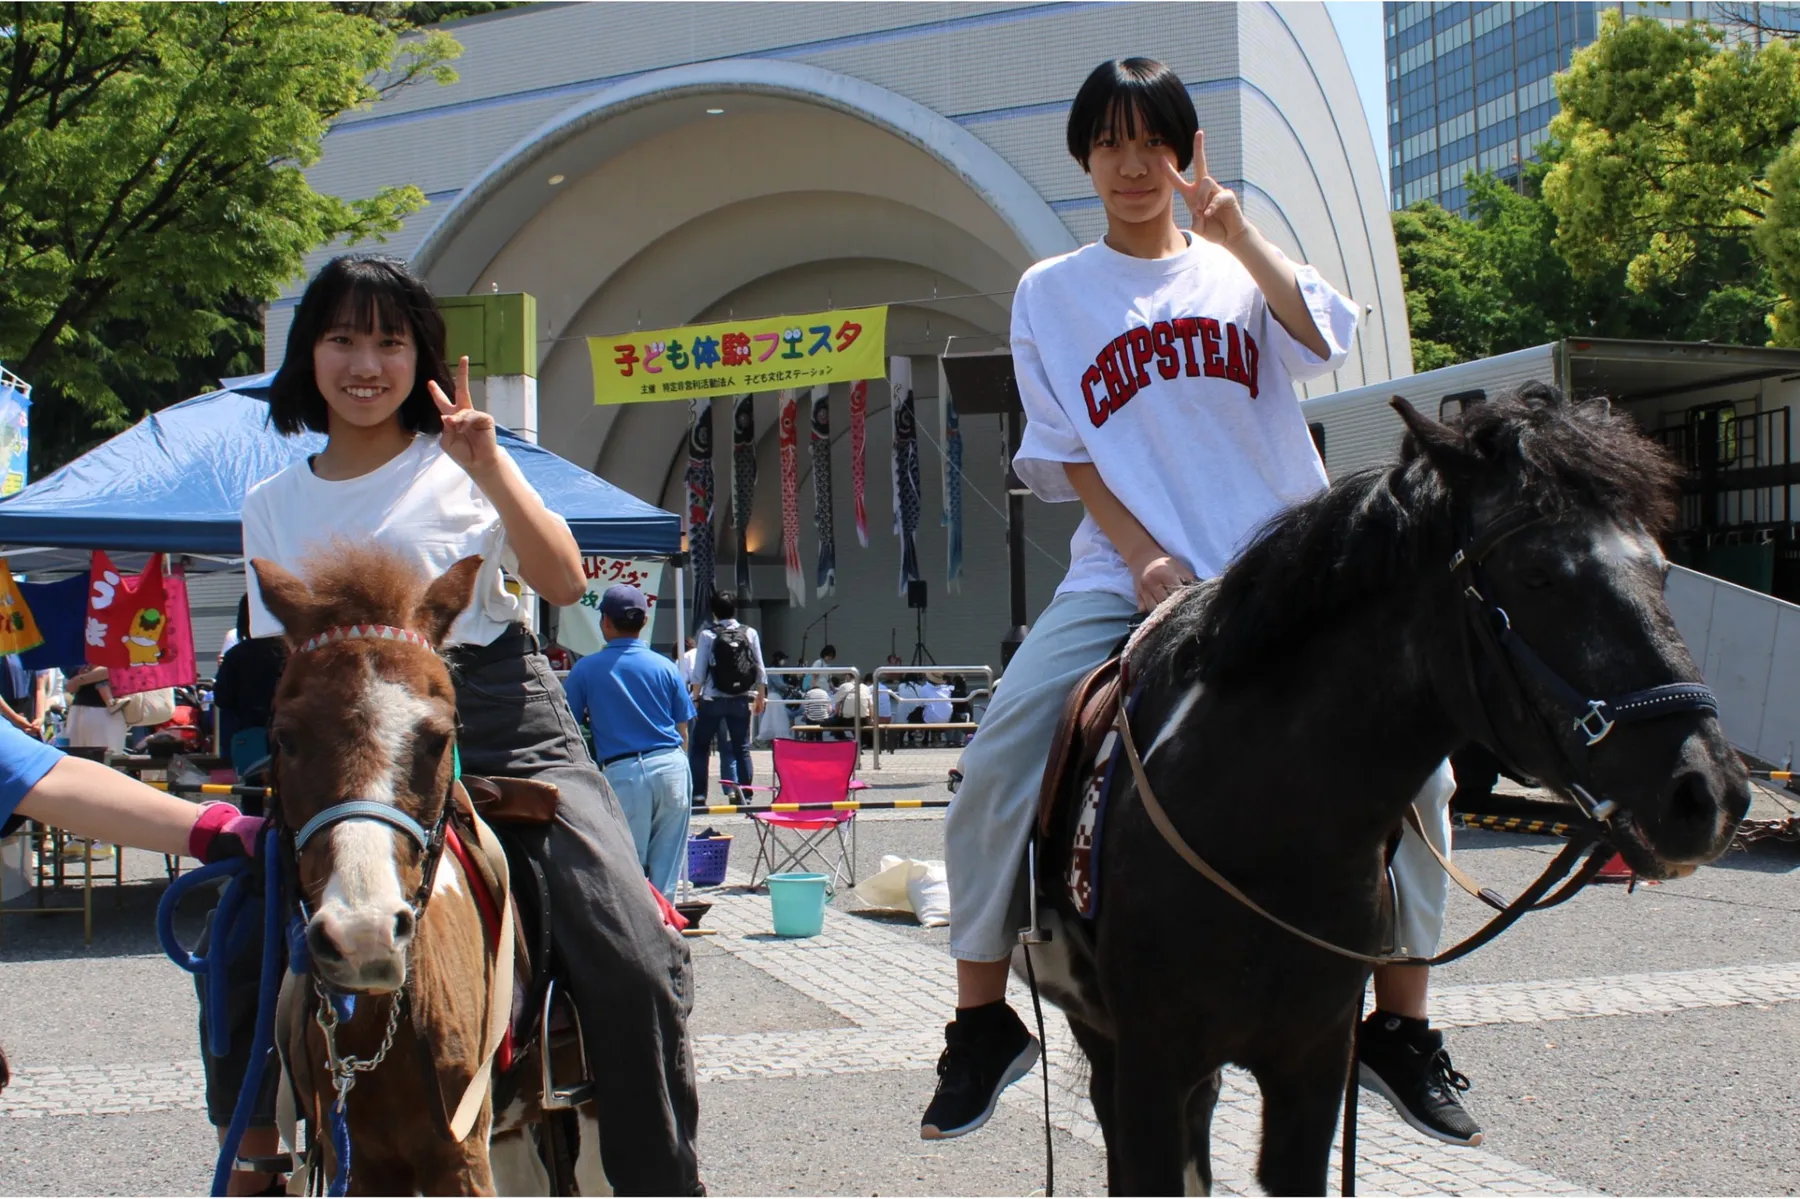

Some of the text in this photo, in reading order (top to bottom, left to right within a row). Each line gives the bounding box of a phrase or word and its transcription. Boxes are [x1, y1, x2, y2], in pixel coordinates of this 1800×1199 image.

[614, 320, 862, 377] 子ども体験フェスタ
[744, 365, 833, 386] 子ども文化ステーション
[1081, 316, 1259, 428] CHIPSTEAD
